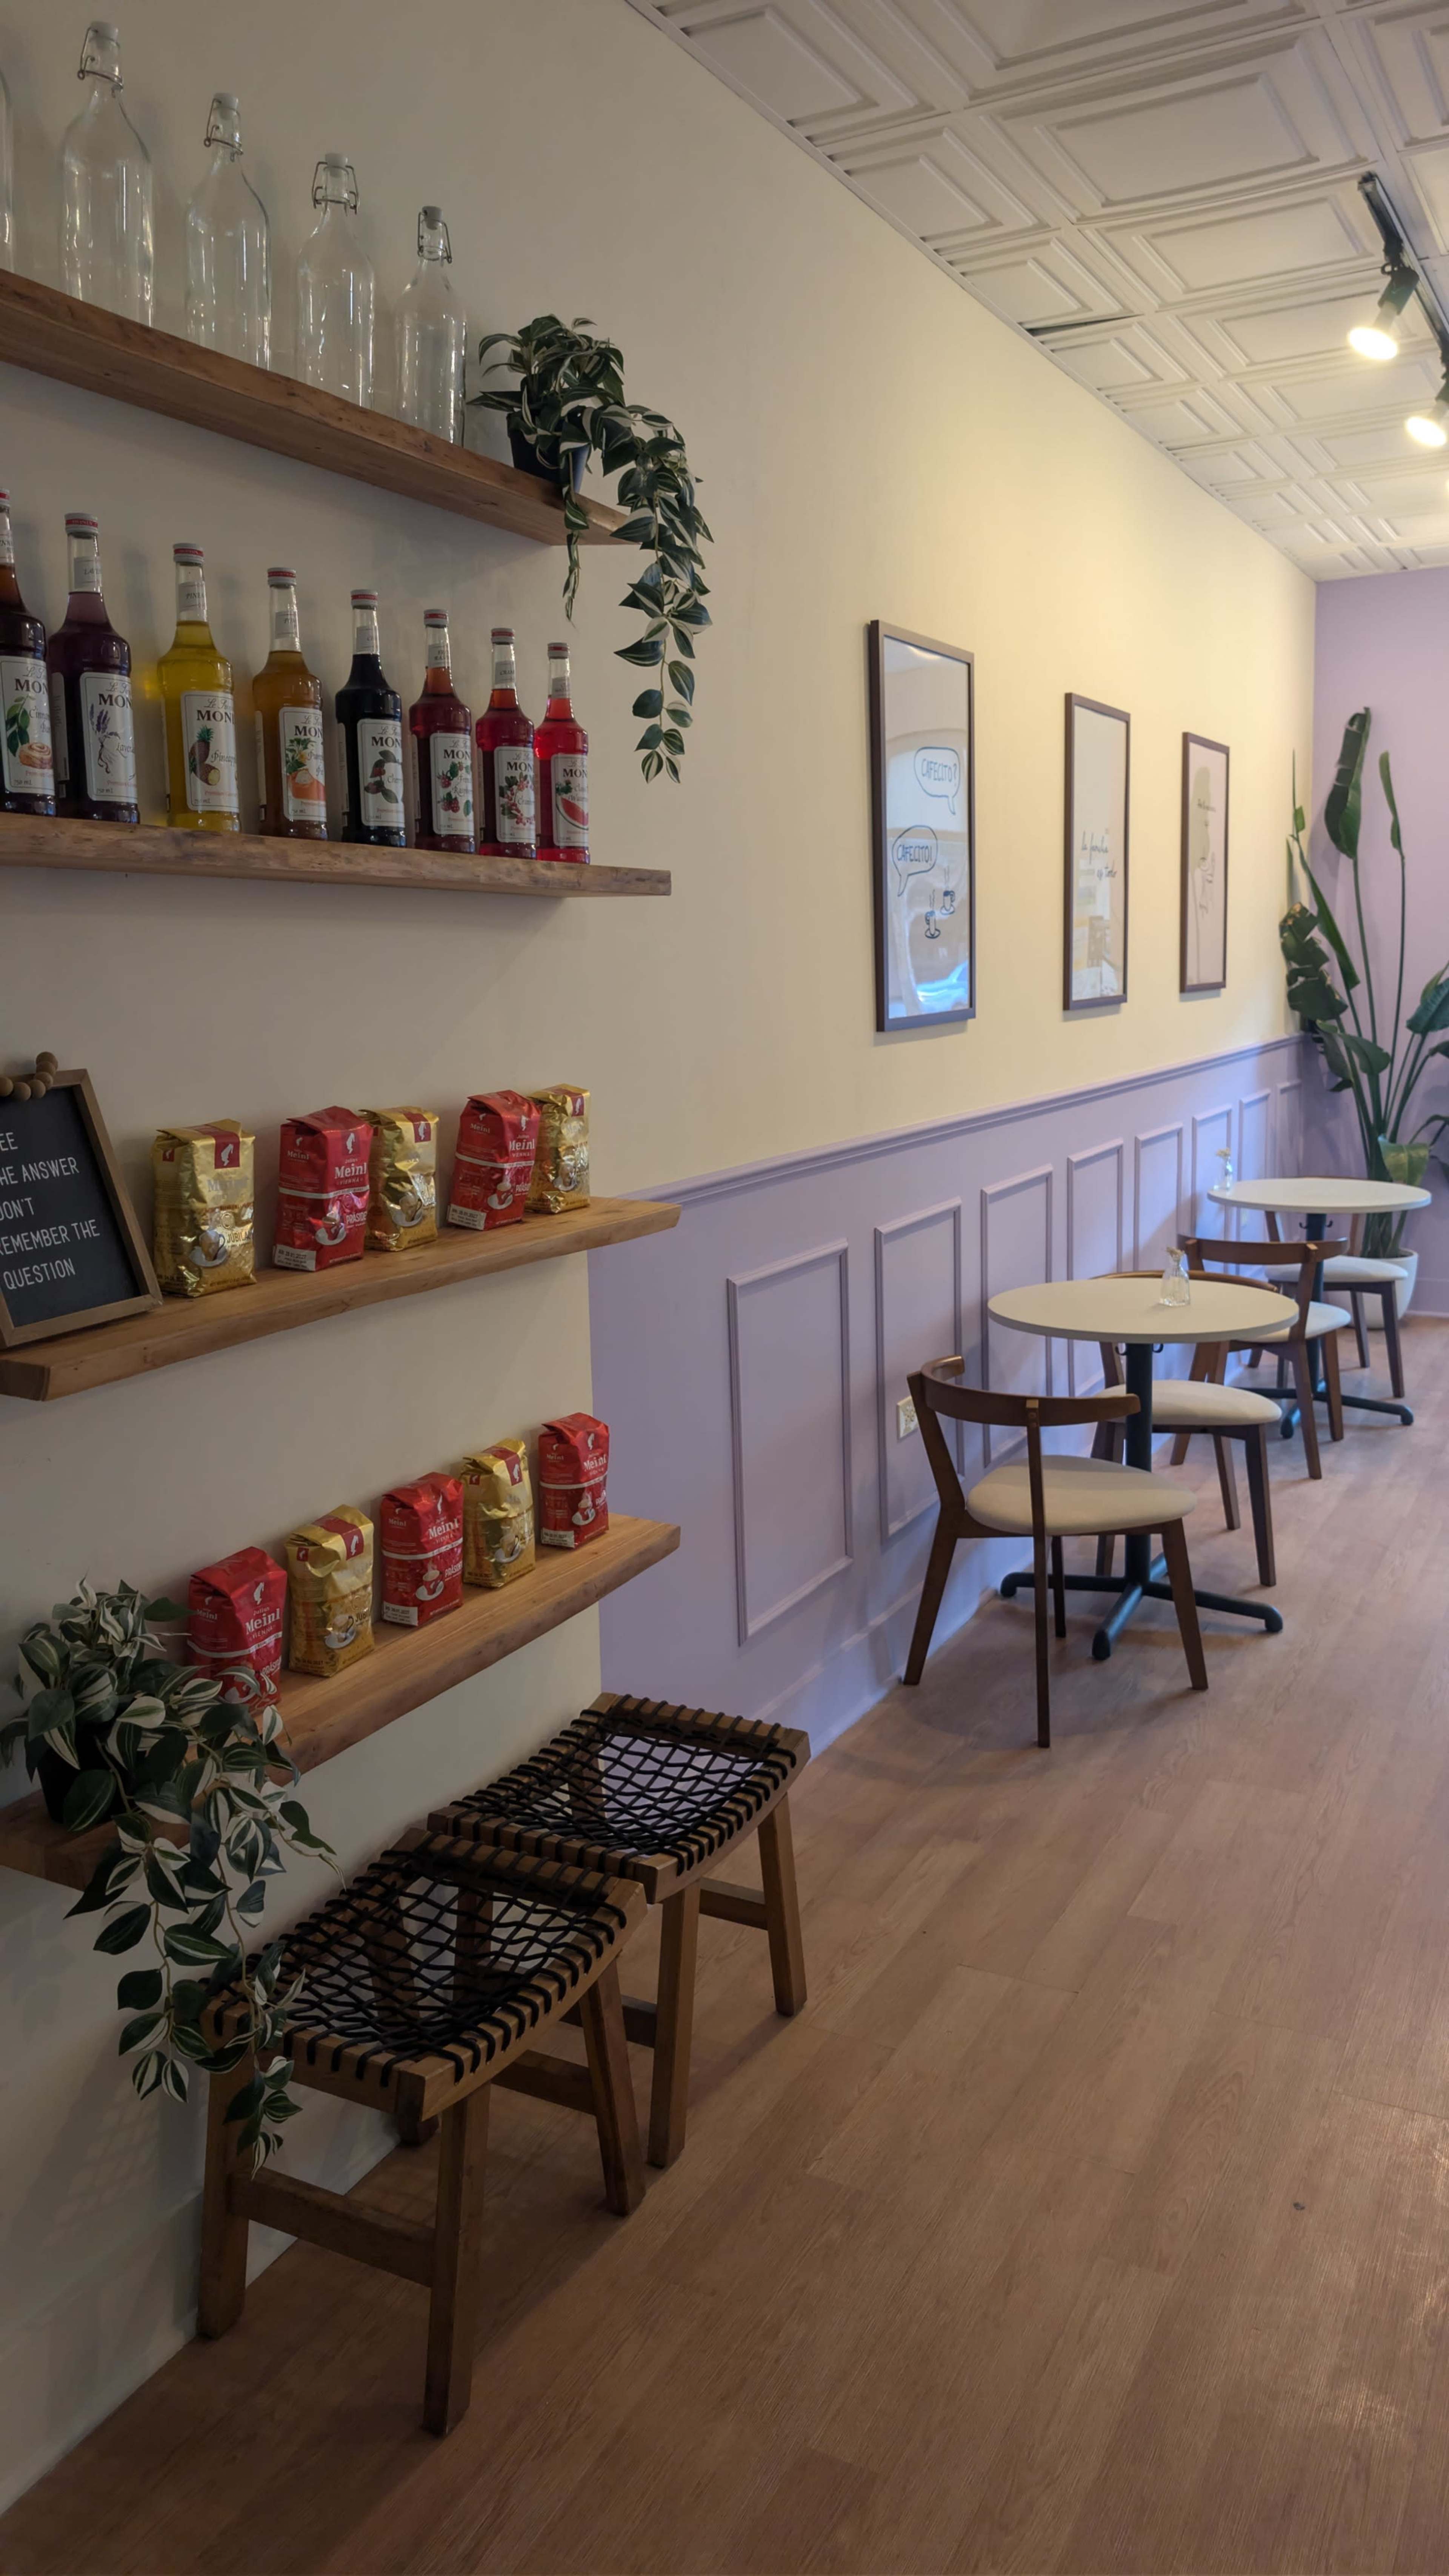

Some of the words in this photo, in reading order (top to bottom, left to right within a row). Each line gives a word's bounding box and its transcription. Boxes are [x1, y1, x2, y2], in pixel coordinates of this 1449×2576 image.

[921, 758, 957, 787] CAFECITO?
[897, 844, 932, 866] CAFECITO!
[471, 1123, 490, 1134] Meinl
[287, 1150, 310, 1160] Meinl
[22, 1157, 80, 1182] ANSWER
[334, 1162, 368, 1179] Meinl
[0, 1225, 71, 1256] EMEMBER
[71, 1219, 101, 1241] THE
[3, 1258, 76, 1290] QUESTION
[388, 1518, 406, 1527] Meinl
[428, 1518, 459, 1539] Meinl
[245, 1608, 280, 1635] Meinl
[253, 1606, 270, 1616] Julius
